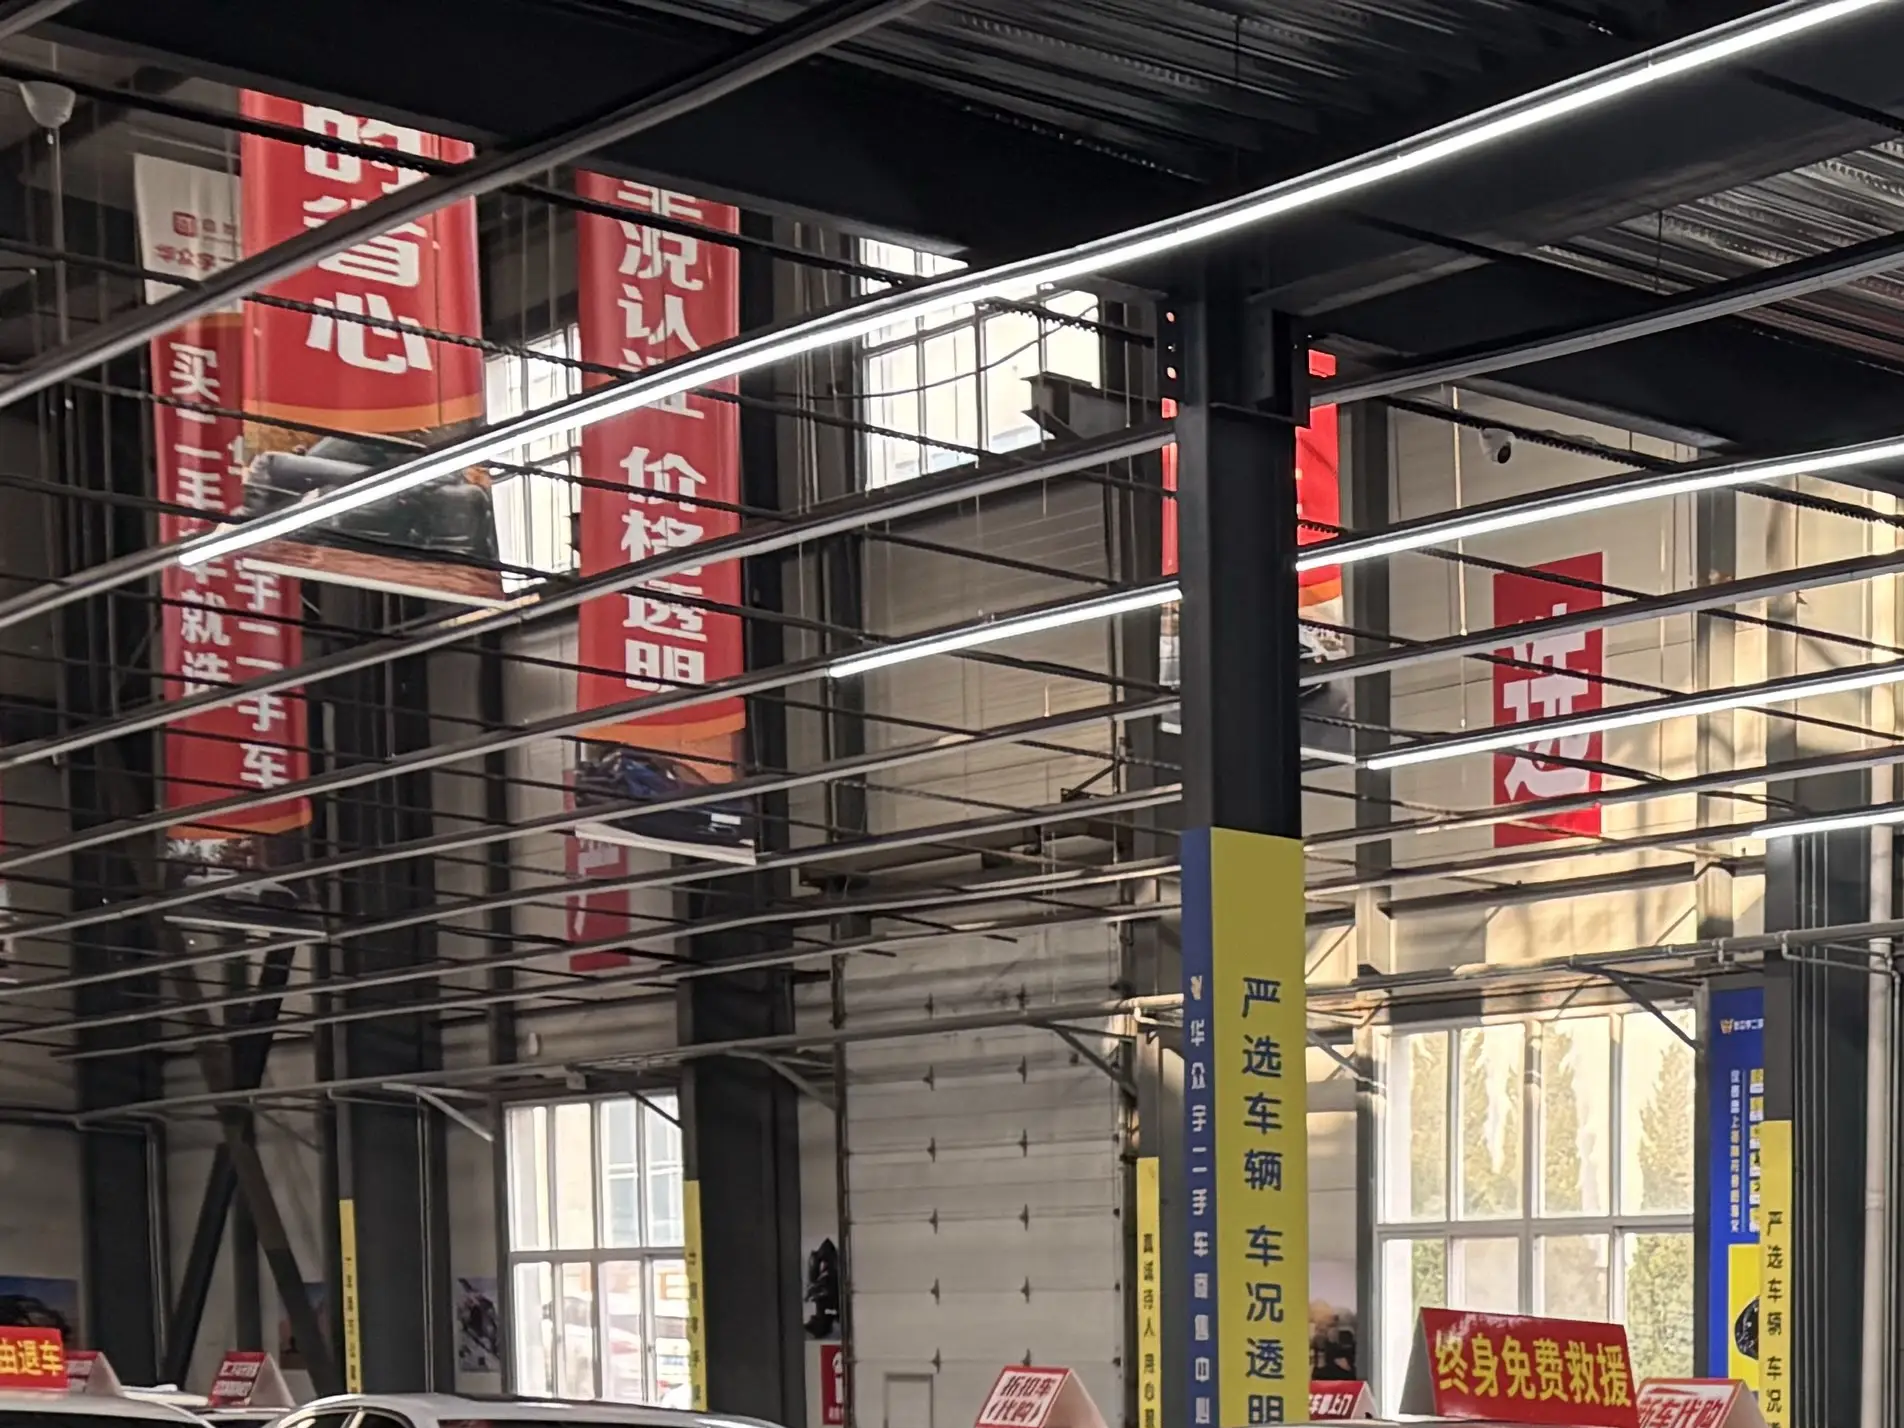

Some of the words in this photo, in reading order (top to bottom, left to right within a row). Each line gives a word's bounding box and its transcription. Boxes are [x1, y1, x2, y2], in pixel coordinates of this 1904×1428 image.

[1242, 977, 1283, 1191] 严选车辆
[1245, 1225, 1284, 1425] 车况透明
[1434, 1330, 1631, 1408] 终身免费救援
